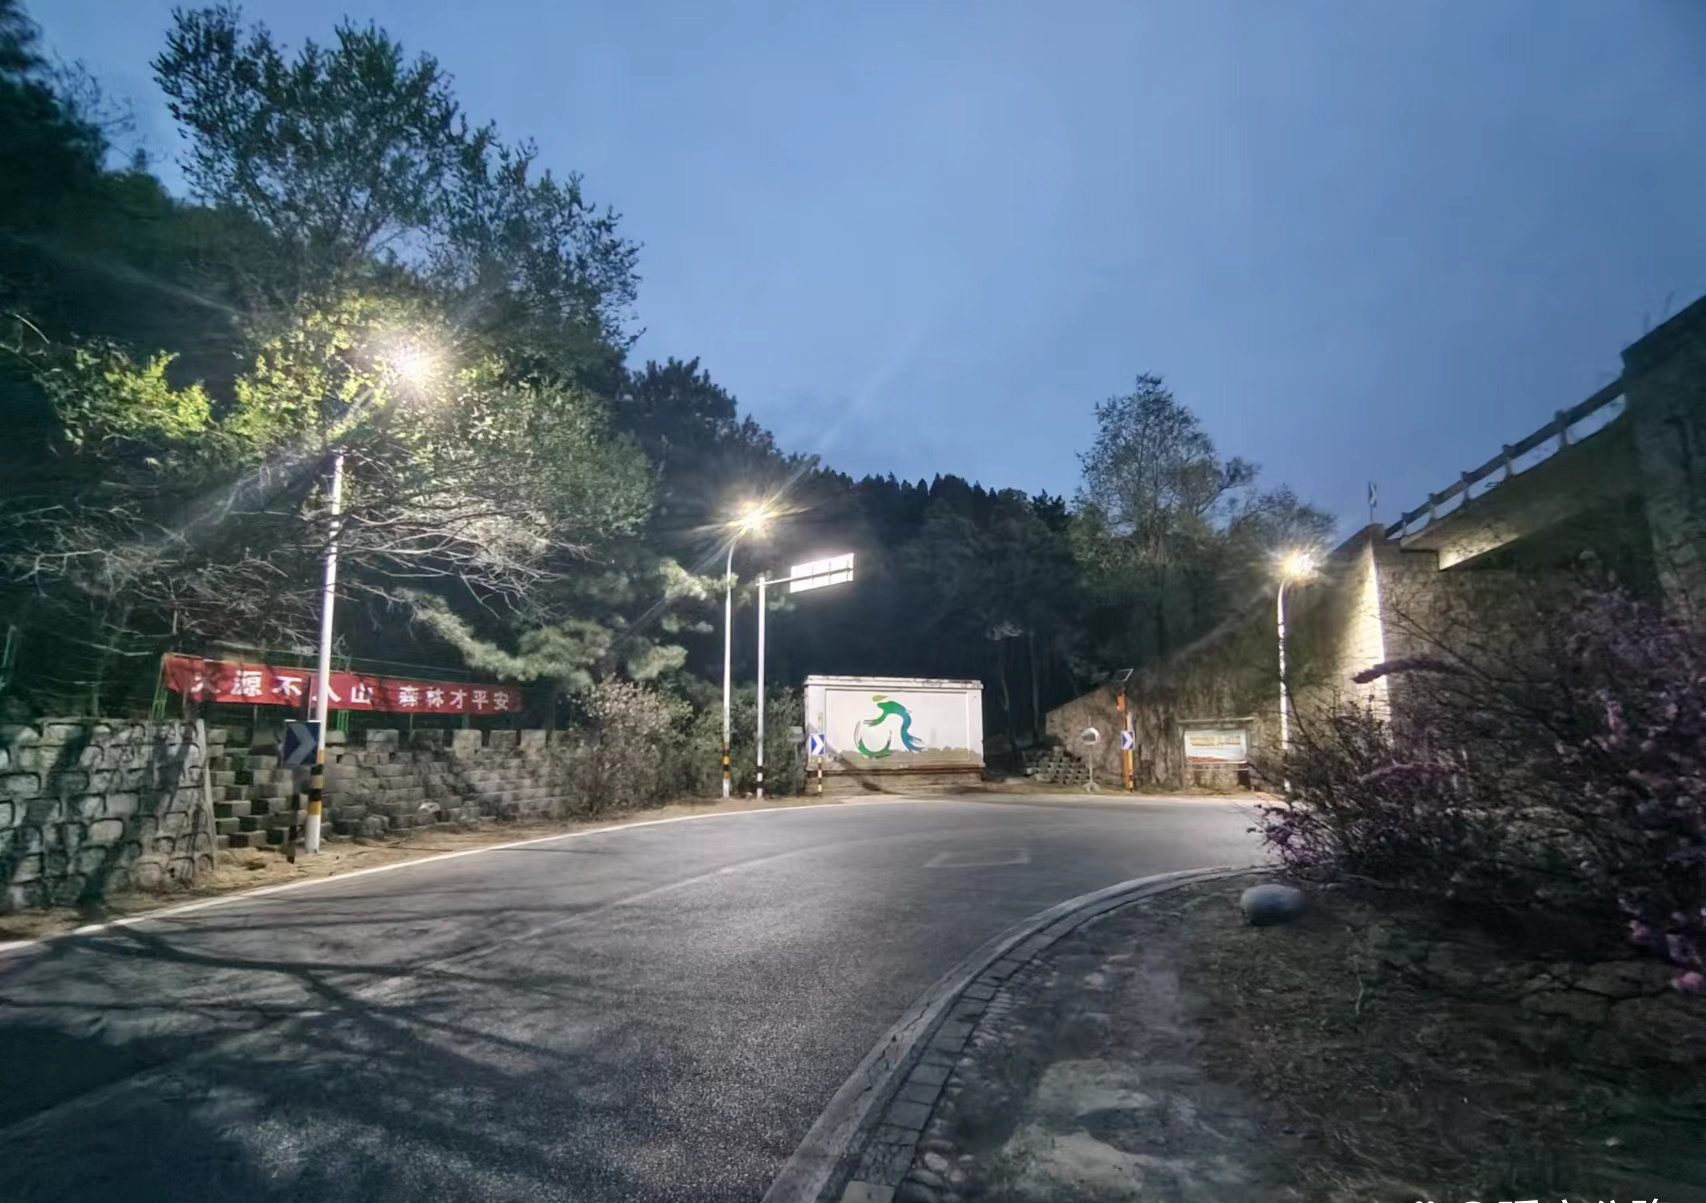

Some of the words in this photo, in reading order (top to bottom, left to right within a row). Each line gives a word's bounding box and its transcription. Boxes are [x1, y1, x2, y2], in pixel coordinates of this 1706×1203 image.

[398, 685, 509, 711] 森林才平安
